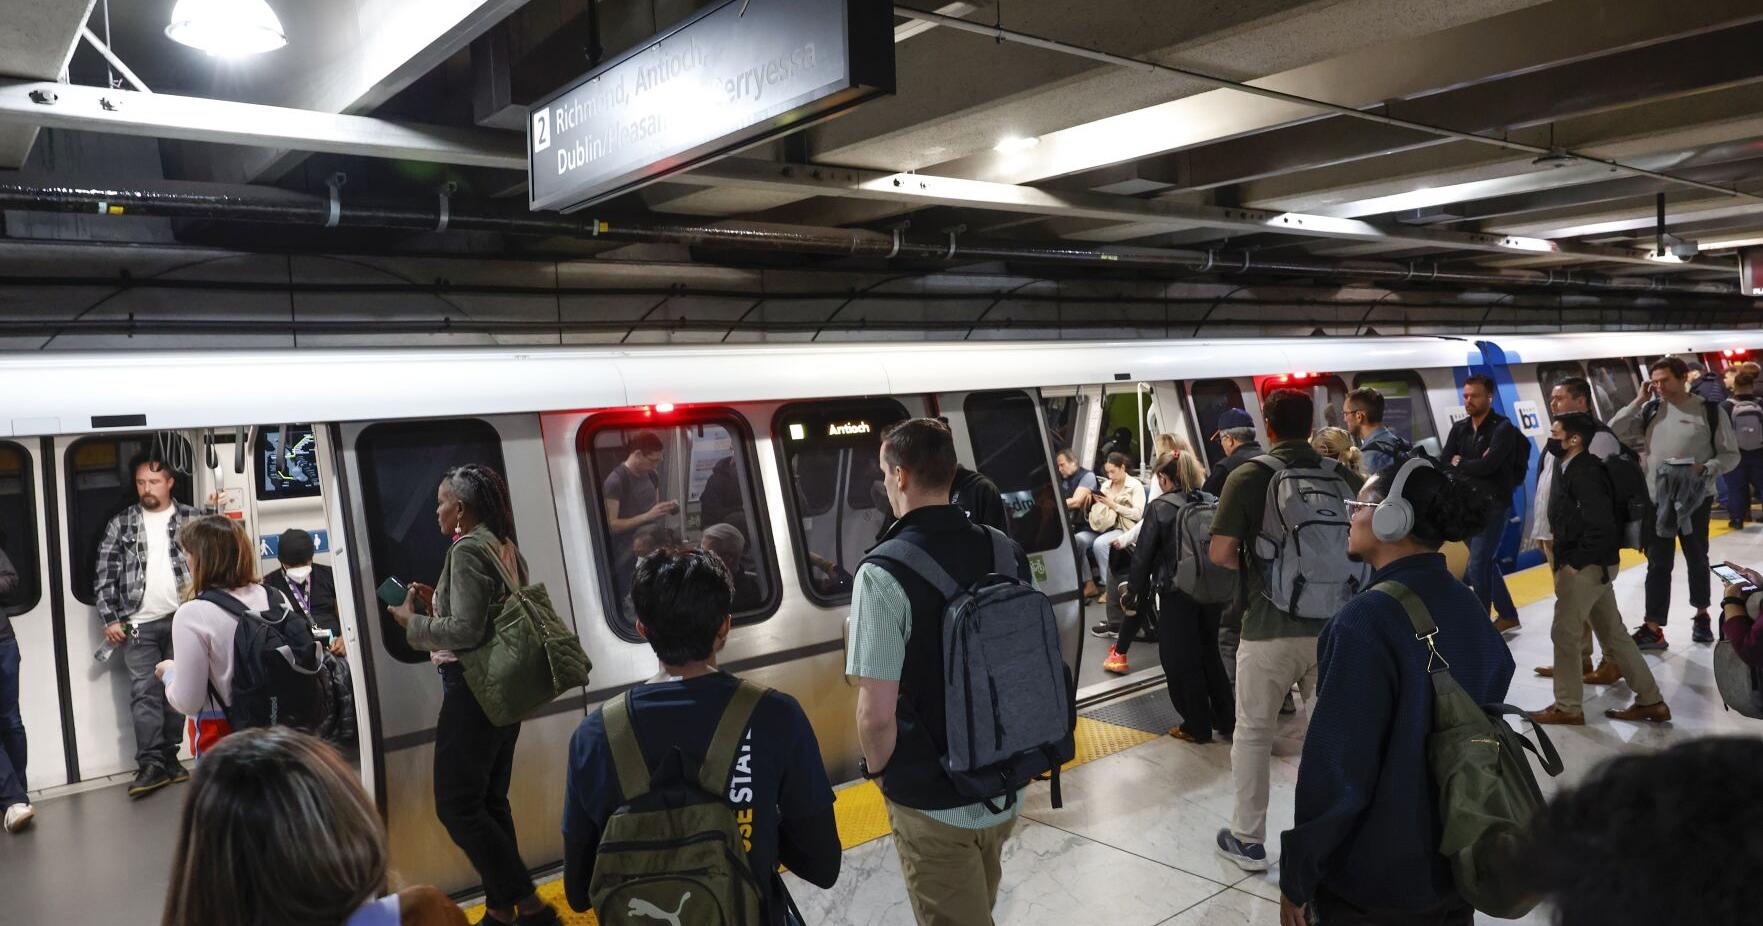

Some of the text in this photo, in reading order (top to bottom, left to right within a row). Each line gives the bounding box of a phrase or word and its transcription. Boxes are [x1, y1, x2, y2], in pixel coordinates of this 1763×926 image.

[712, 41, 817, 104] erryessa
[537, 115, 548, 146] 2
[829, 420, 871, 436] Antioch
